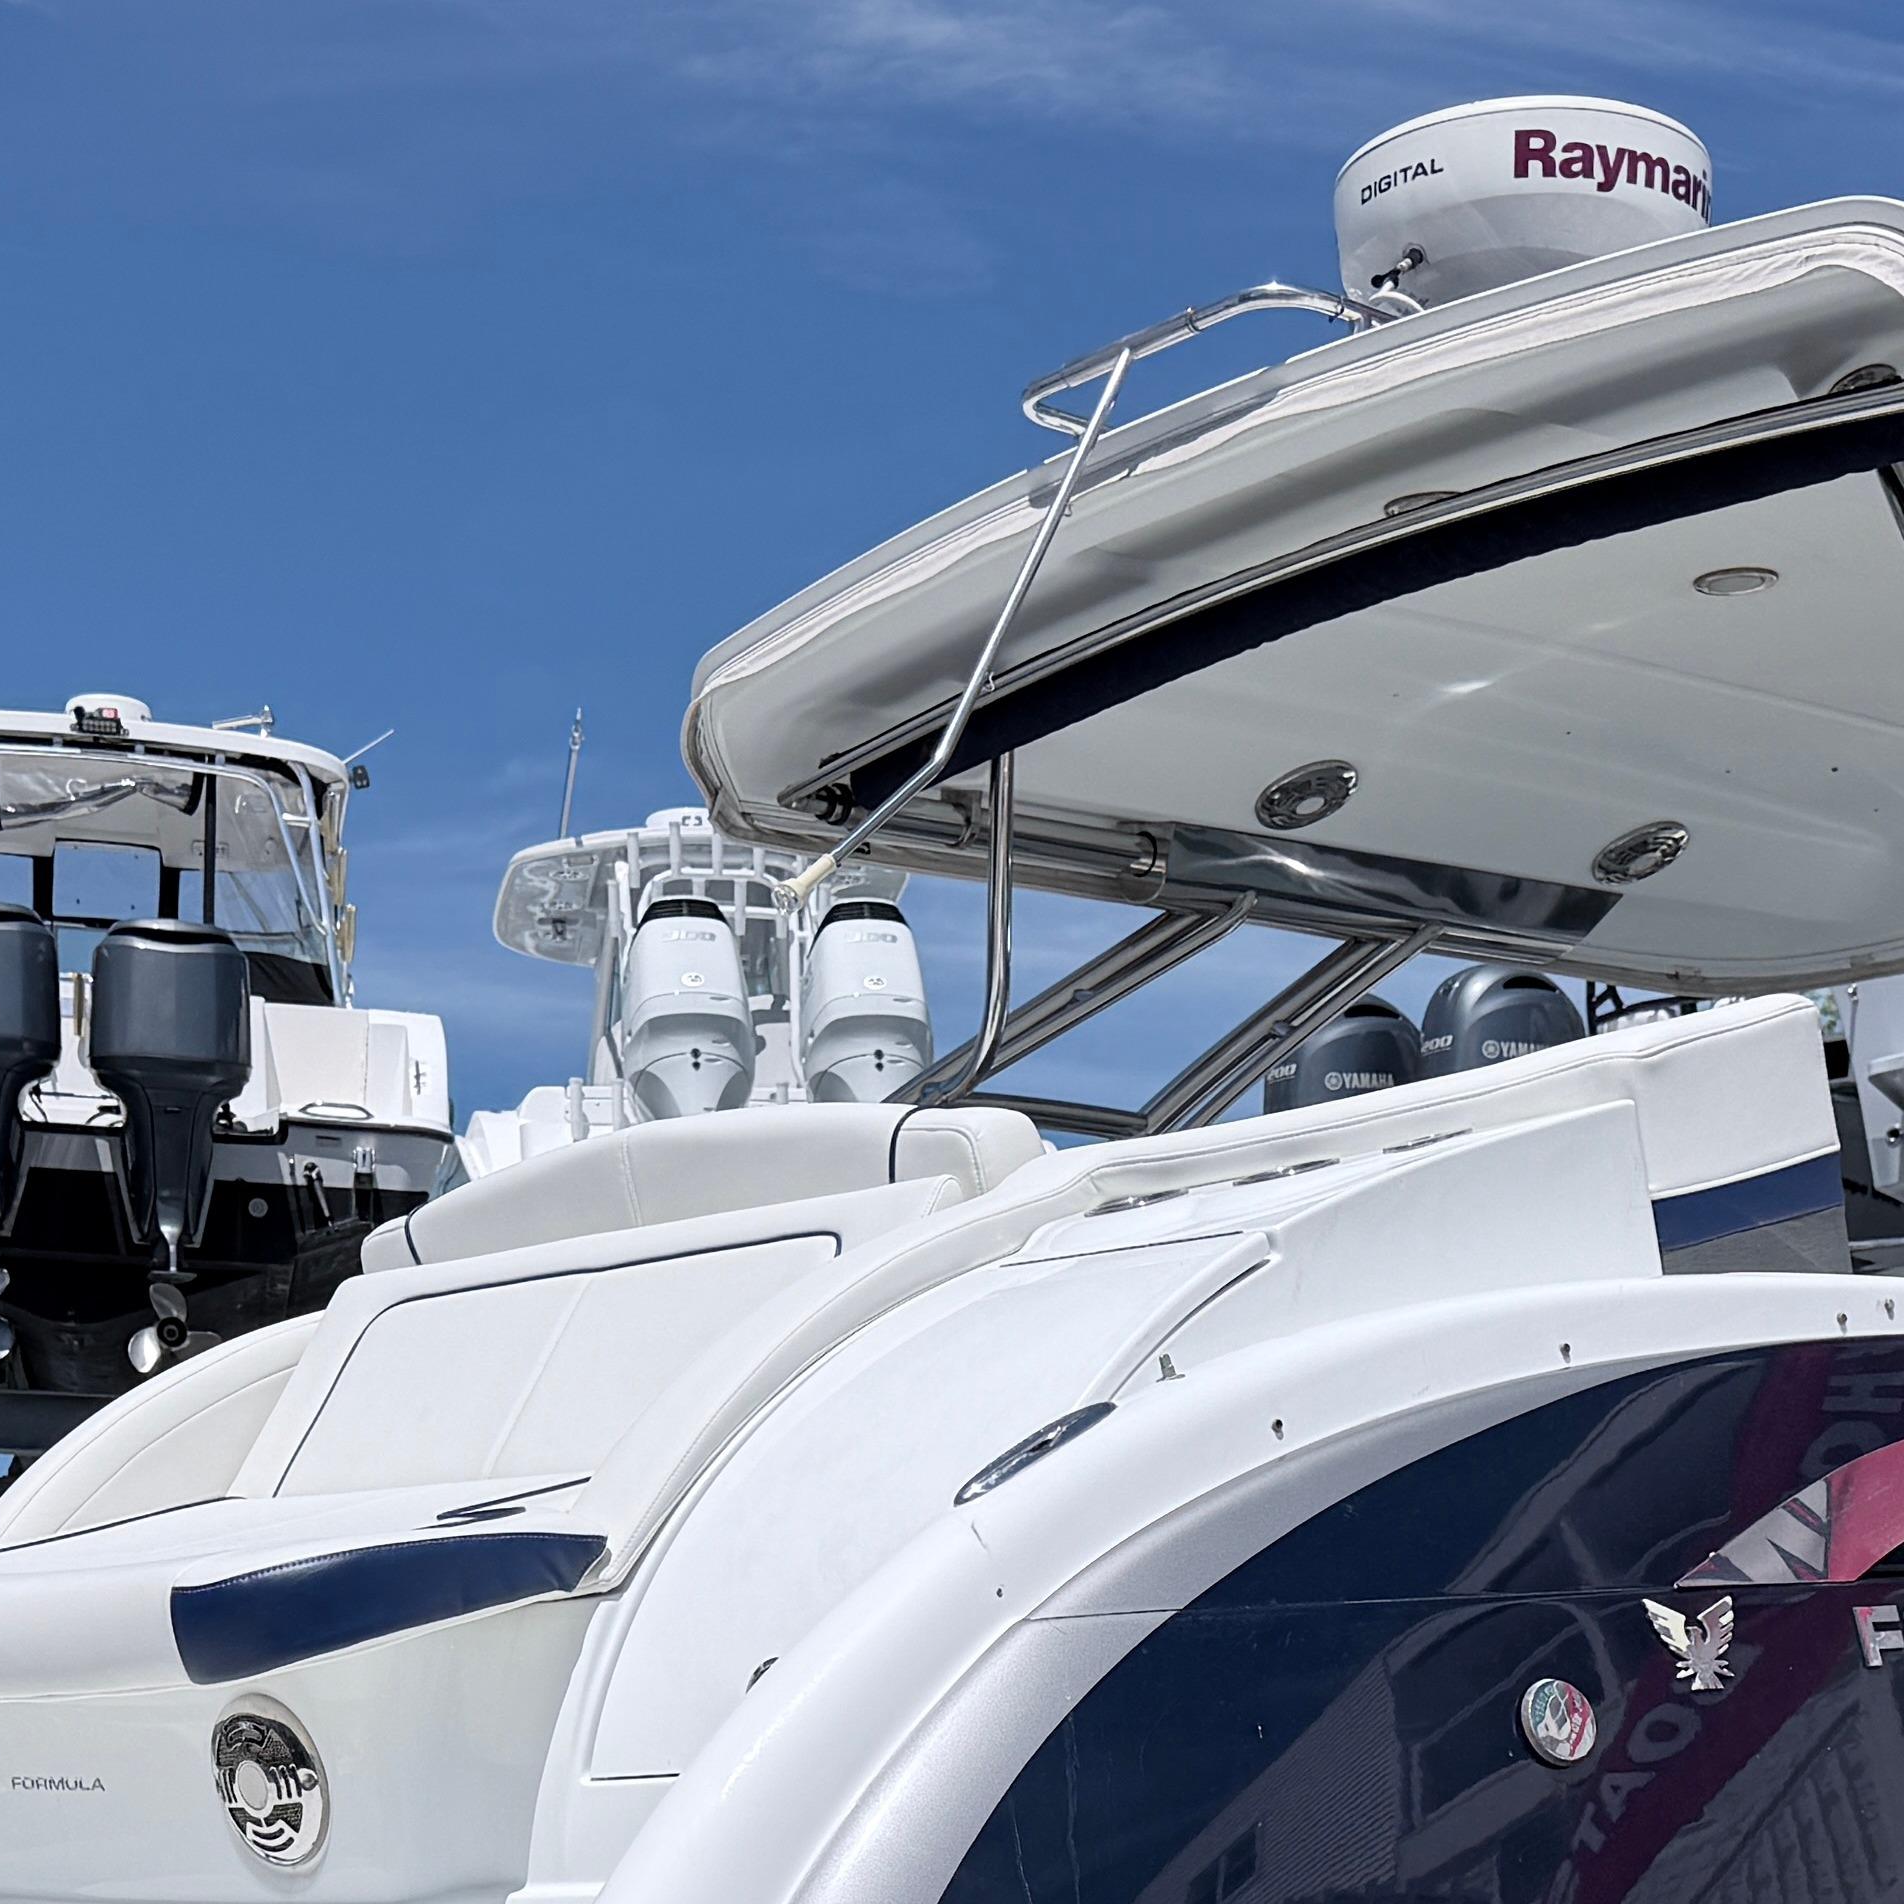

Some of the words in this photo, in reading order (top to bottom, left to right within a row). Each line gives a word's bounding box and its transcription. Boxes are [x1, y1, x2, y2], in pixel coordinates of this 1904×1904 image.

[1360, 157, 1445, 206] DIGITAL
[1342, 1072, 1395, 1089] YAMAHA
[11, 1776, 106, 1793] FORMULA
